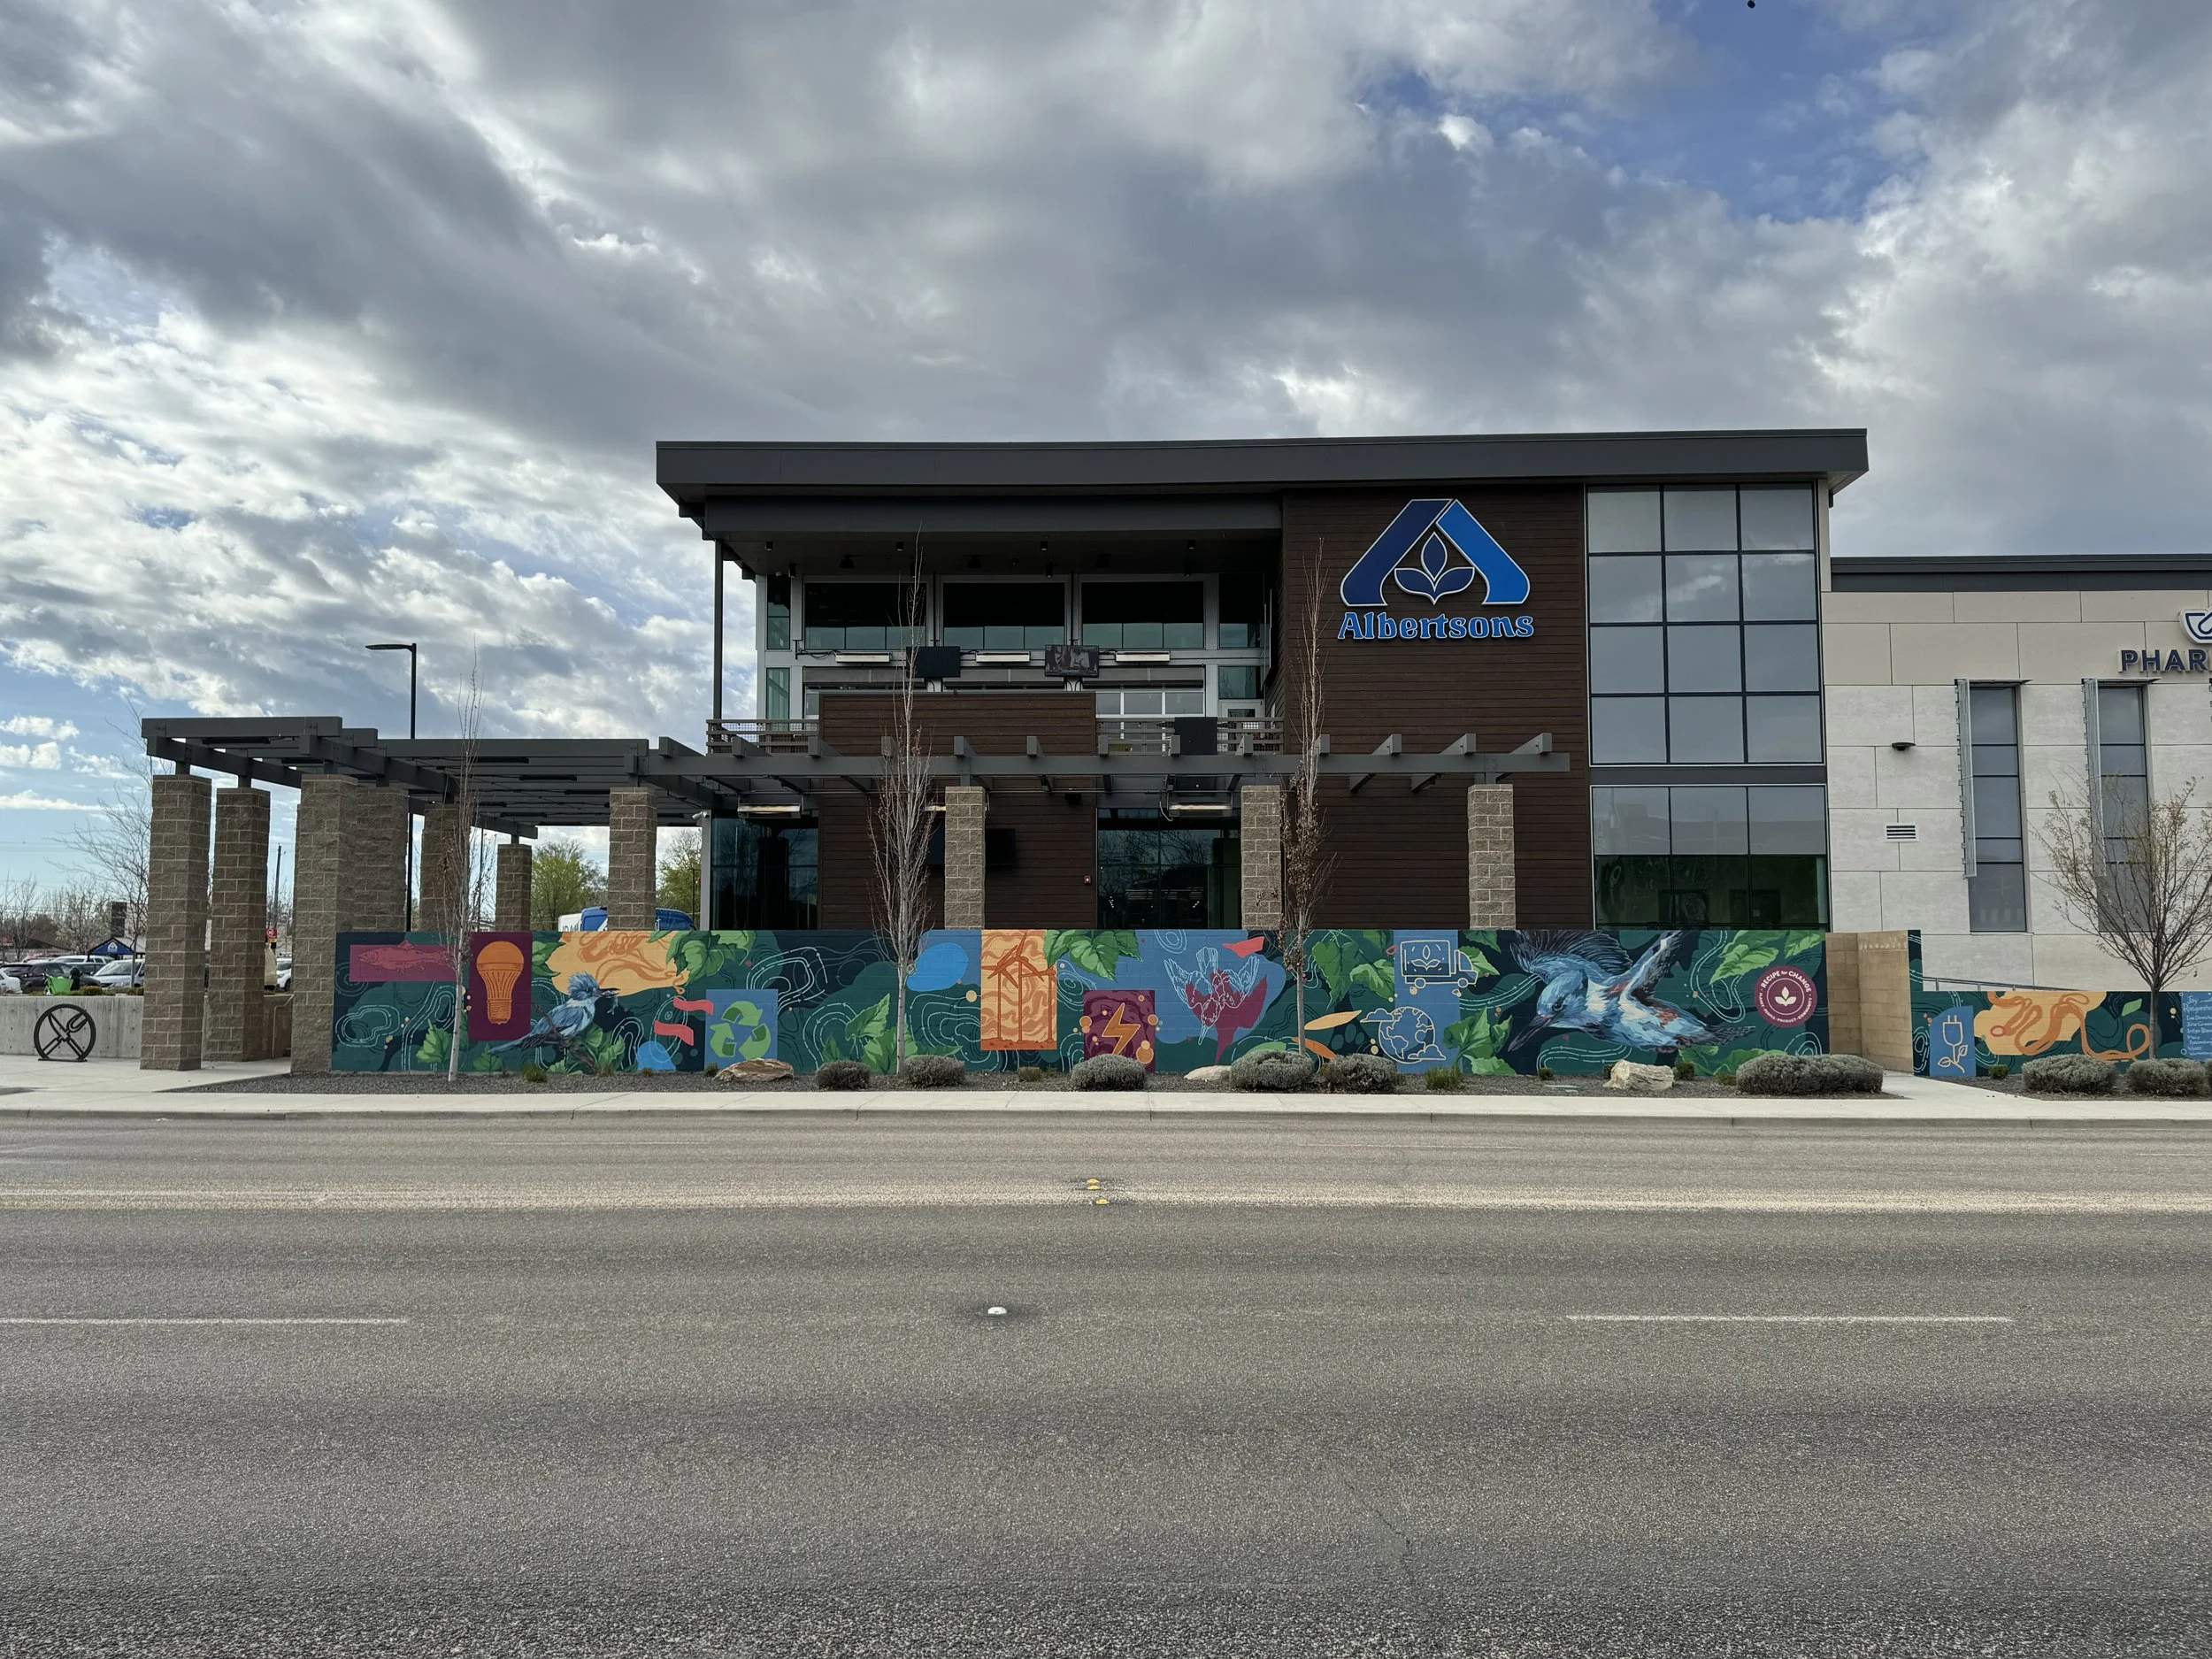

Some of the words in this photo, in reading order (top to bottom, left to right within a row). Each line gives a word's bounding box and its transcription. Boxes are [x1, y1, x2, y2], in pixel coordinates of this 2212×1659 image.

[1337, 611, 1535, 641] Albertsons
[2120, 649, 2212, 672] PHAR
[1761, 971, 1780, 988] RECIPE
[1788, 971, 1812, 993] CHANGE
